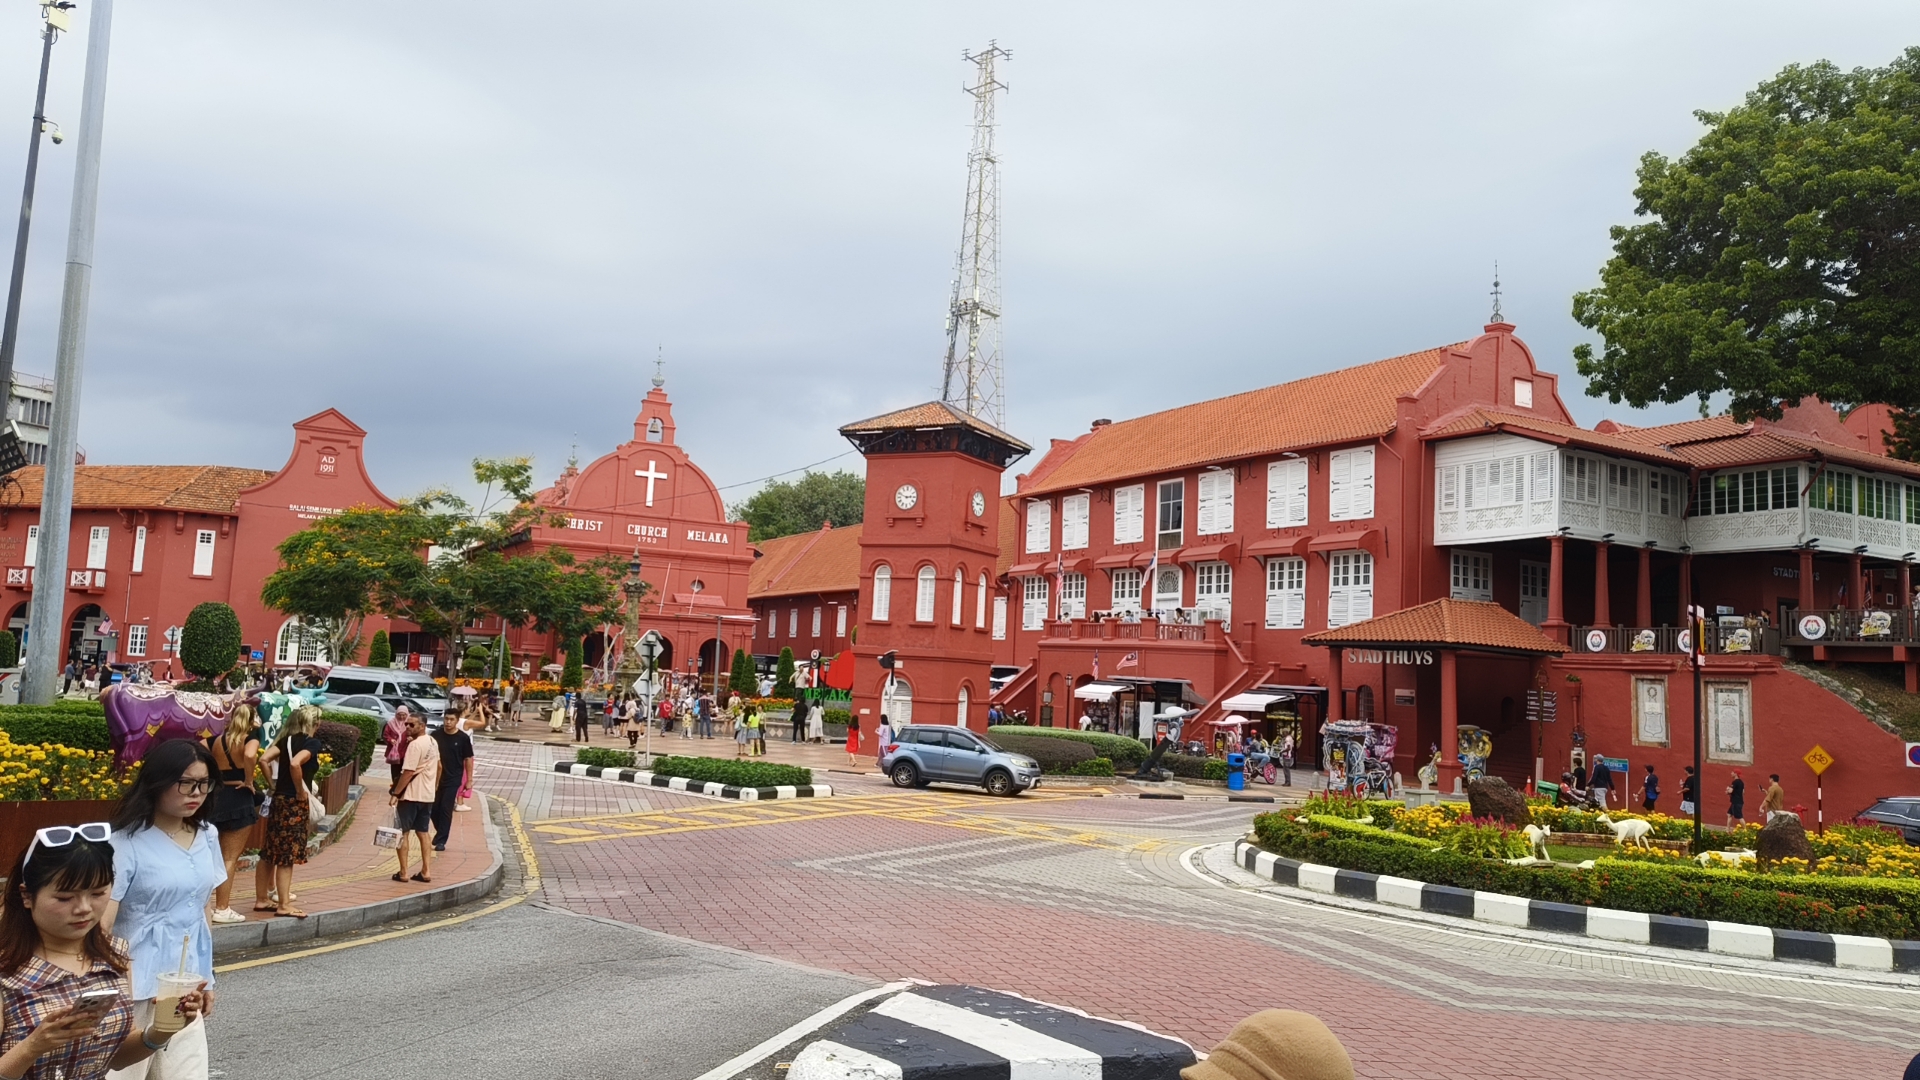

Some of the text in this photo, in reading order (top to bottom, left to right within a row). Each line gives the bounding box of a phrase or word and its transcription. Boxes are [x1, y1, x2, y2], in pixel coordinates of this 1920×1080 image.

[321, 456, 335, 464] AD
[320, 464, 334, 473] 1951
[564, 517, 603, 532] CHRIST
[627, 523, 668, 538] CHURCH
[637, 535, 657, 544] 1753
[687, 529, 729, 544] MELAKA
[1773, 566, 1820, 581] STADTS
[1348, 649, 1433, 665] STADTHUYS
